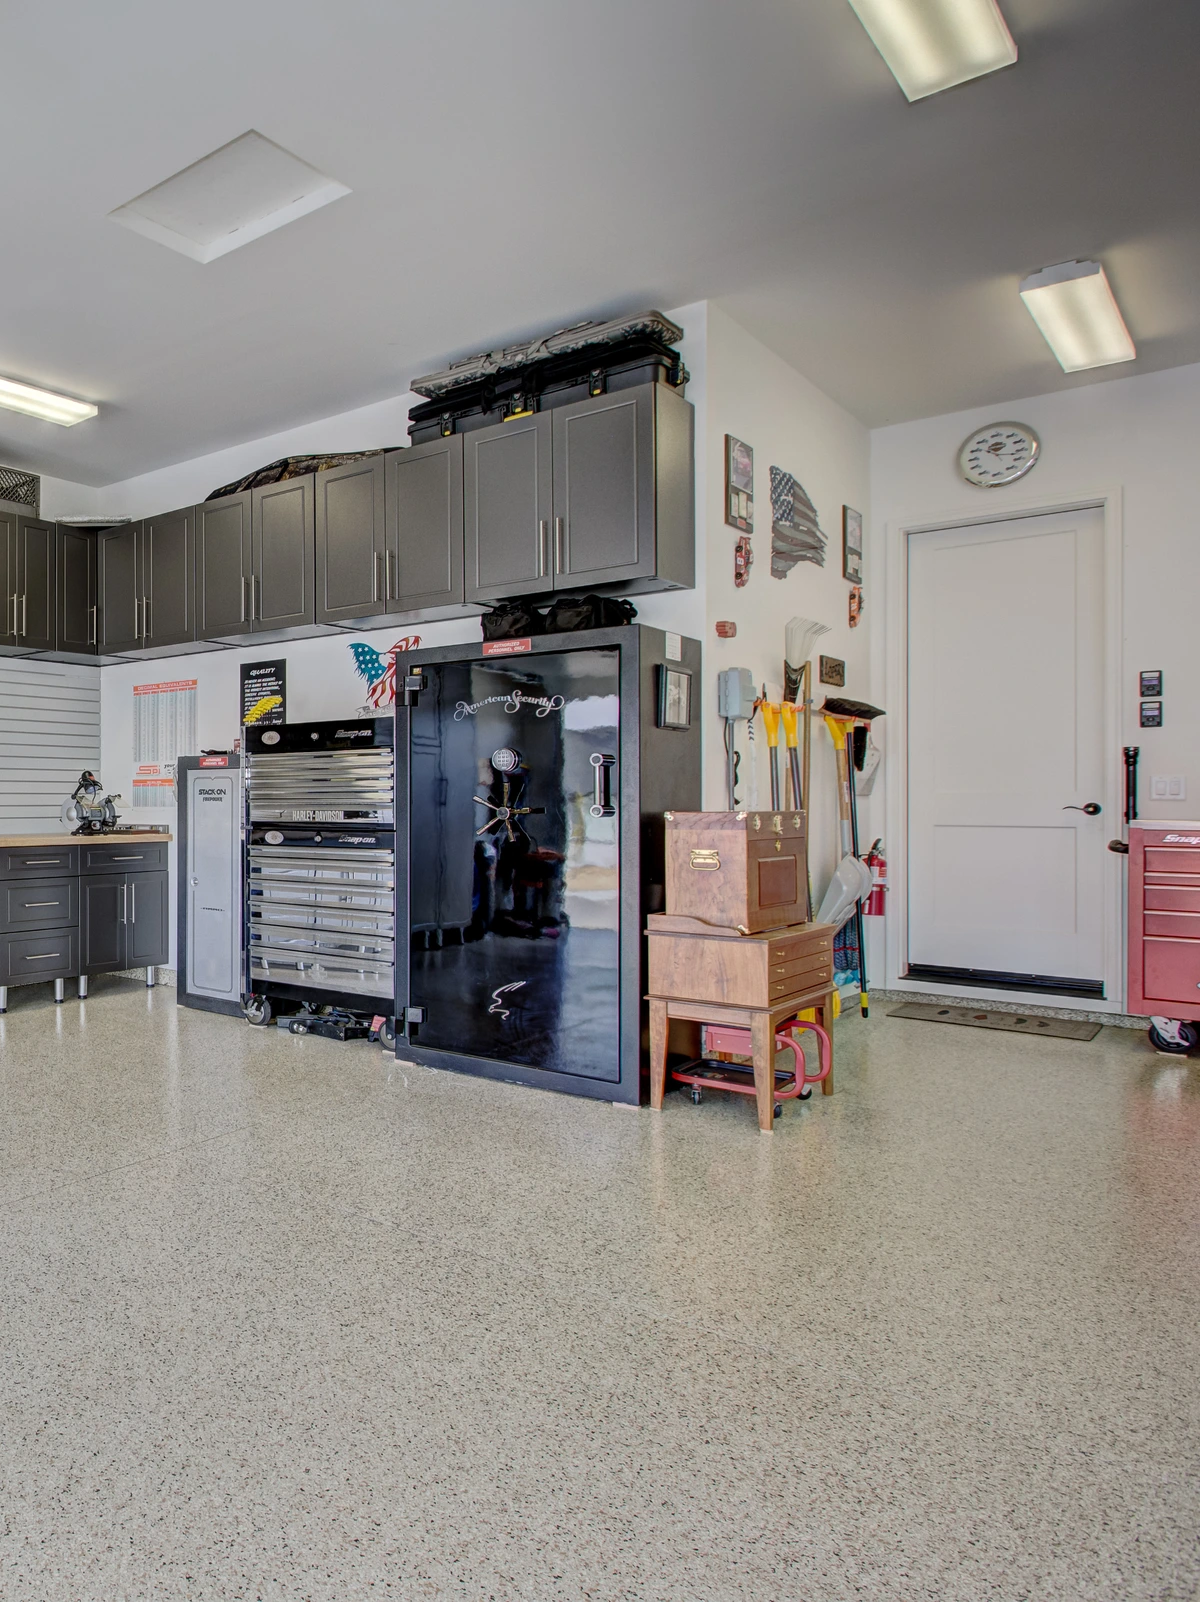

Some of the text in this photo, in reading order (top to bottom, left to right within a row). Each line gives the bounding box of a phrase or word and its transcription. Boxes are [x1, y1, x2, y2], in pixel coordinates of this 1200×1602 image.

[250, 668, 275, 676] QUALITY
[454, 689, 565, 721] American Security
[292, 810, 344, 821] HARLEY-DAVIDSON
